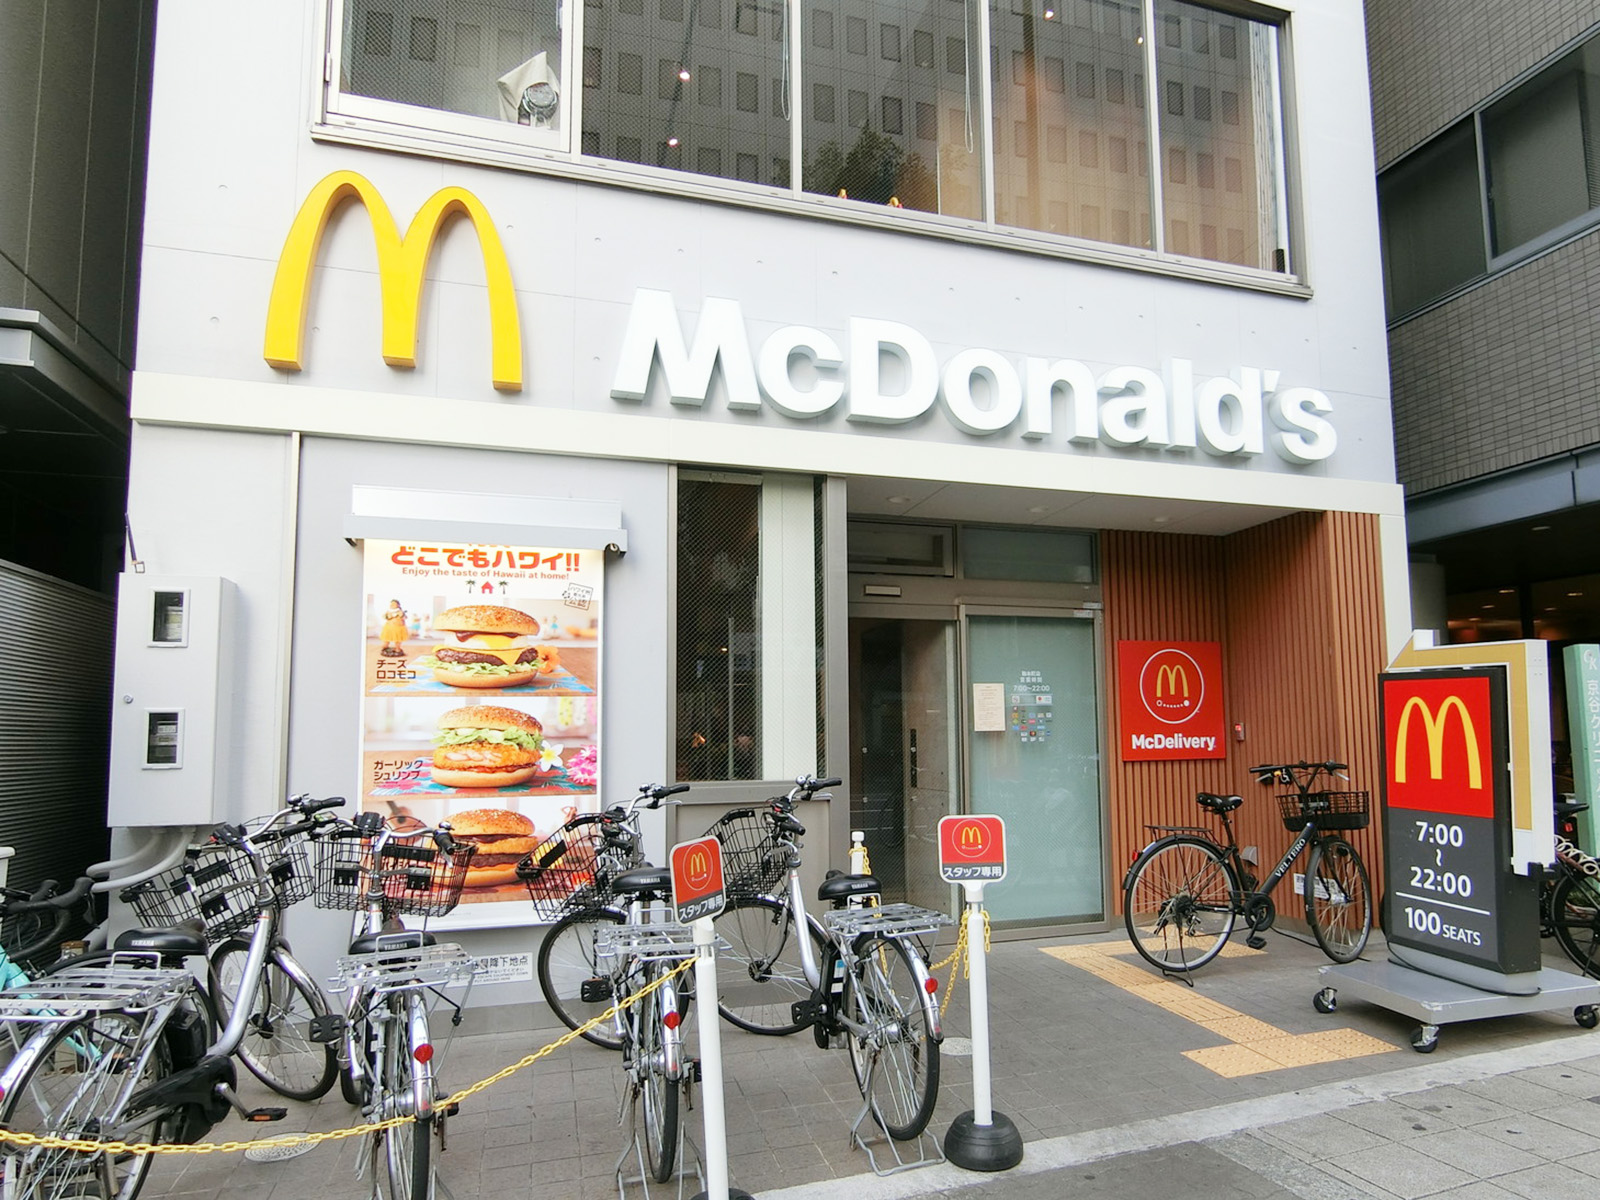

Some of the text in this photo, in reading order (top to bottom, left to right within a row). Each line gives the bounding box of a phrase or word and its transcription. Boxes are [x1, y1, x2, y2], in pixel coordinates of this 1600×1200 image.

[610, 287, 1338, 466] McDonald's
[391, 545, 580, 572] どこでもハワイ!!
[402, 567, 569, 580] Enjoy the taste of Hawaii at home!
[376, 658, 407, 669] チーズ
[376, 670, 416, 680] ロコモコ
[1131, 733, 1215, 751] McDelivery
[373, 759, 423, 770] ガーリック
[373, 770, 421, 781] シュリンプ
[1415, 820, 1463, 848] 7:00
[943, 866, 1002, 878] スタッフ専用
[1410, 866, 1472, 898] 22:00
[679, 894, 723, 922] スタッフ専用
[1404, 907, 1482, 947] 100 SEATS
